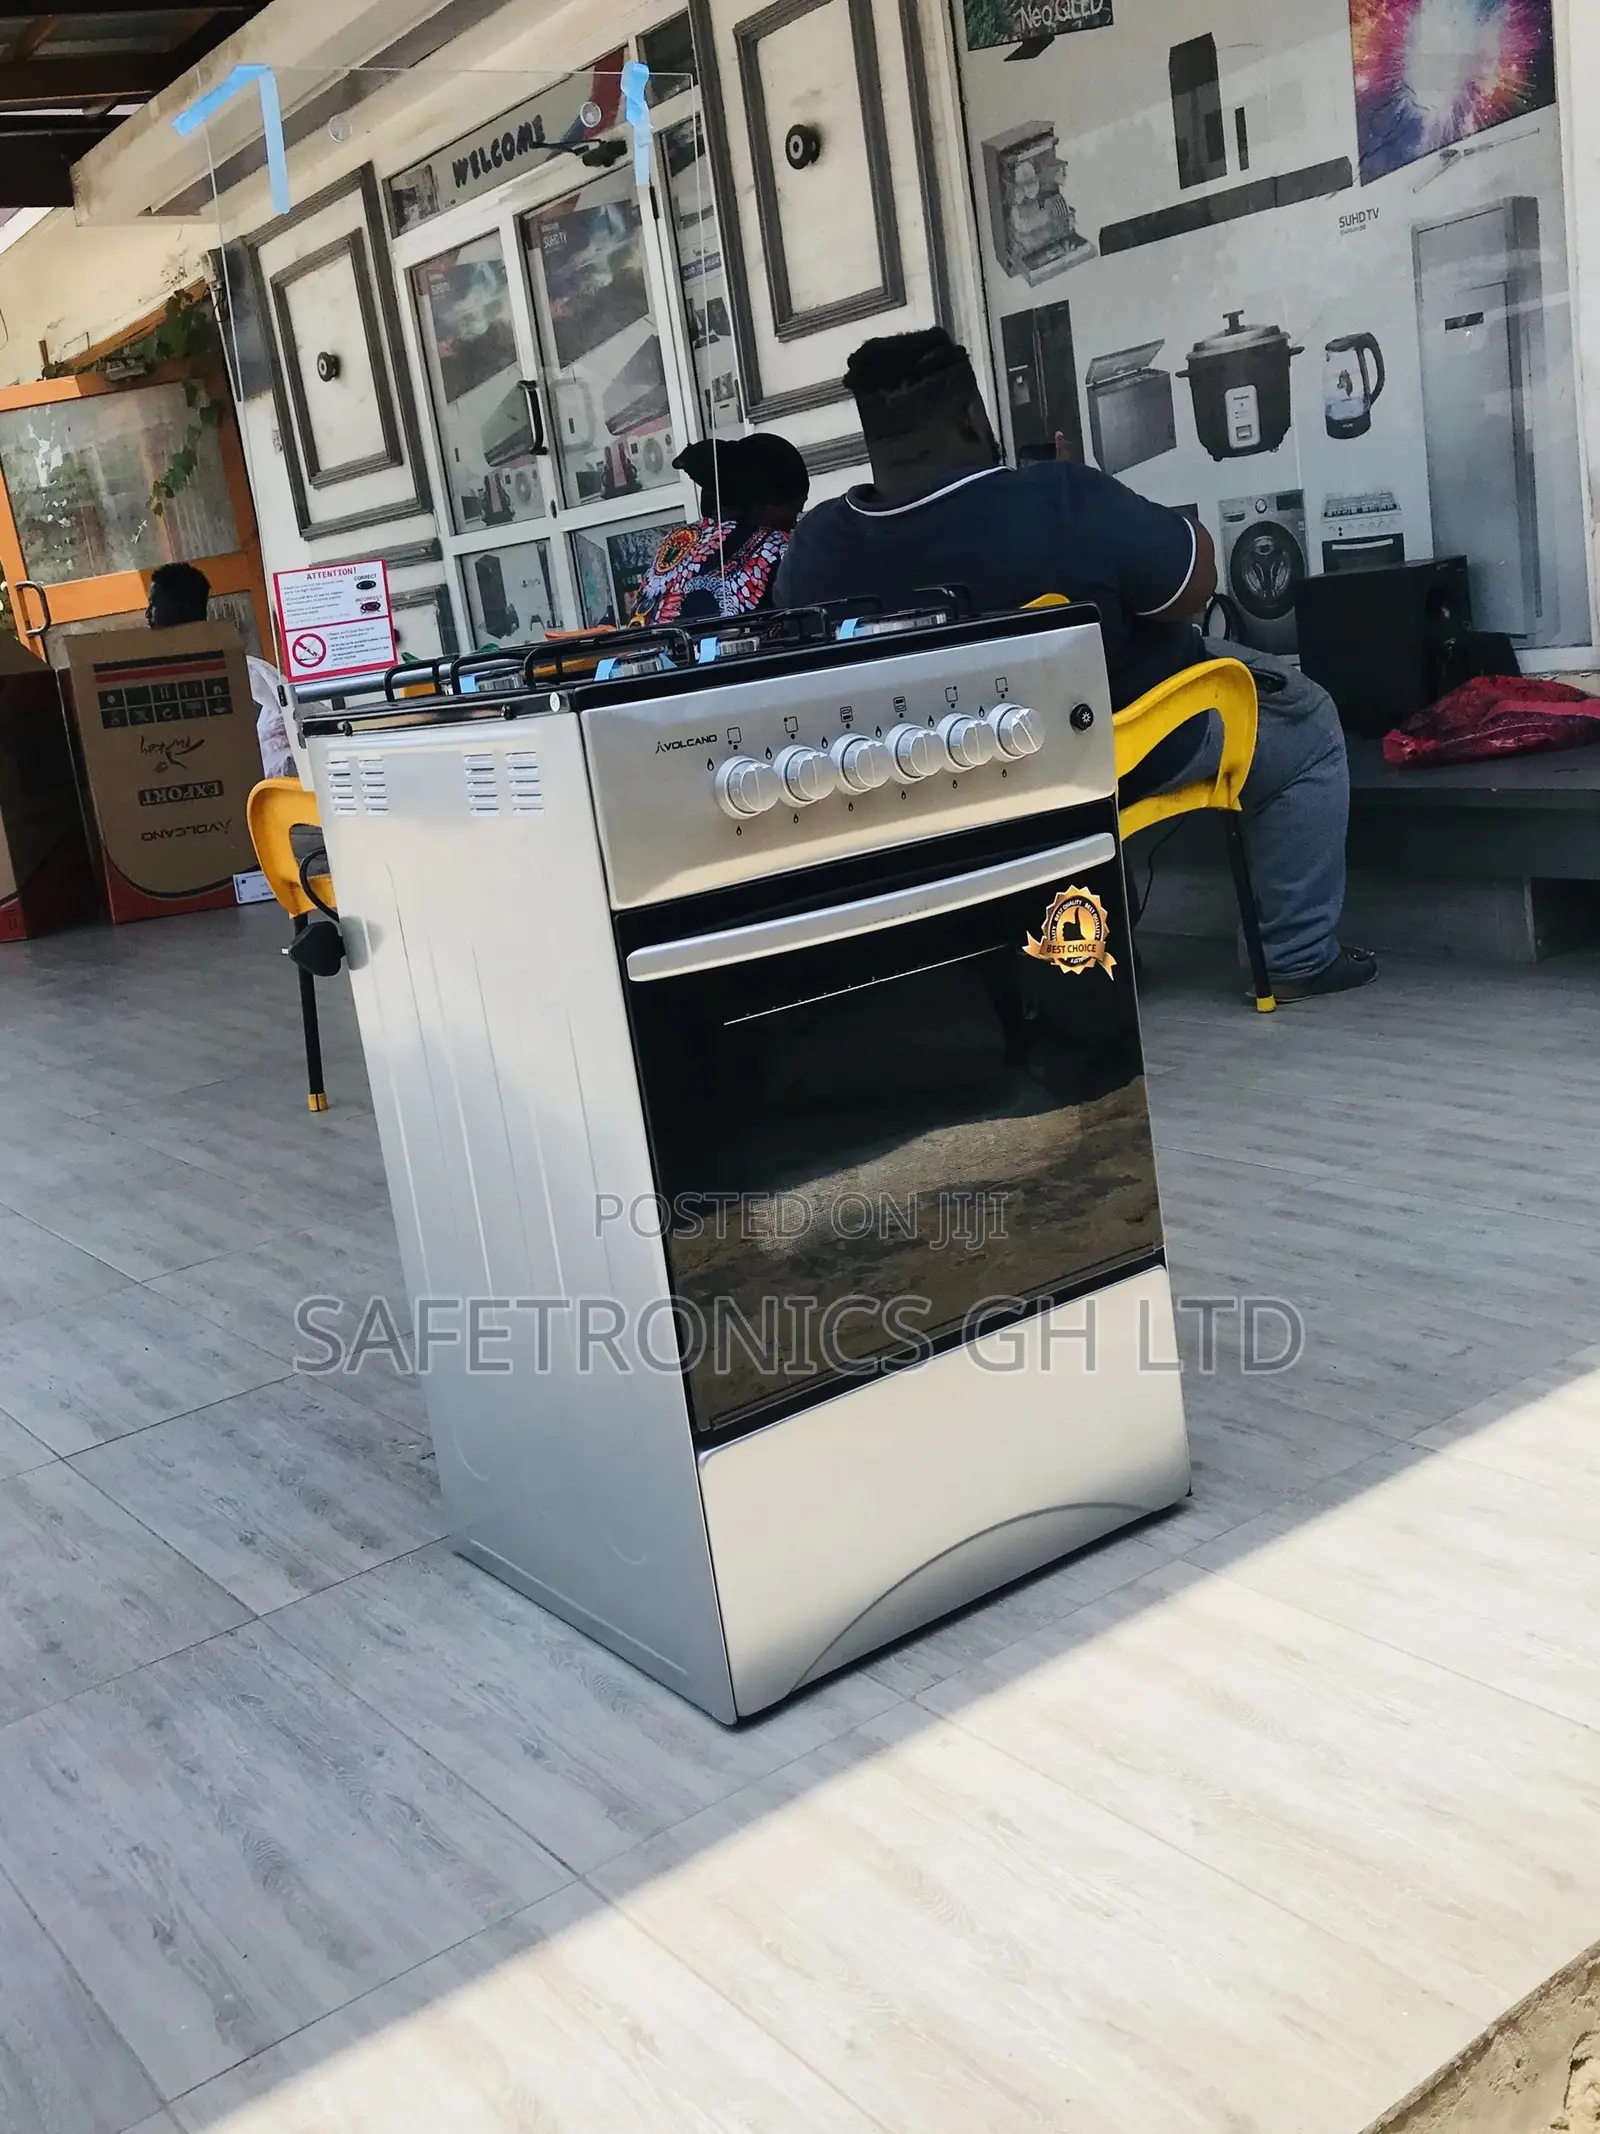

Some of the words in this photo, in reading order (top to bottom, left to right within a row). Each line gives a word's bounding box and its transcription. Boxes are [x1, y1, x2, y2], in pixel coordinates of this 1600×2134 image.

[452, 114, 546, 188] WELCOME
[1339, 211, 1366, 228] SUHD
[307, 567, 357, 580] ATTENTION!
[355, 595, 383, 603] INCORRECT
[664, 734, 718, 751] VOLCANO
[144, 783, 219, 804] EXPORT
[141, 824, 220, 842] VOLCANO
[1084, 902, 1095, 914] BEST
[1046, 944, 1066, 954] BEST
[1067, 943, 1097, 953] CHOICE
